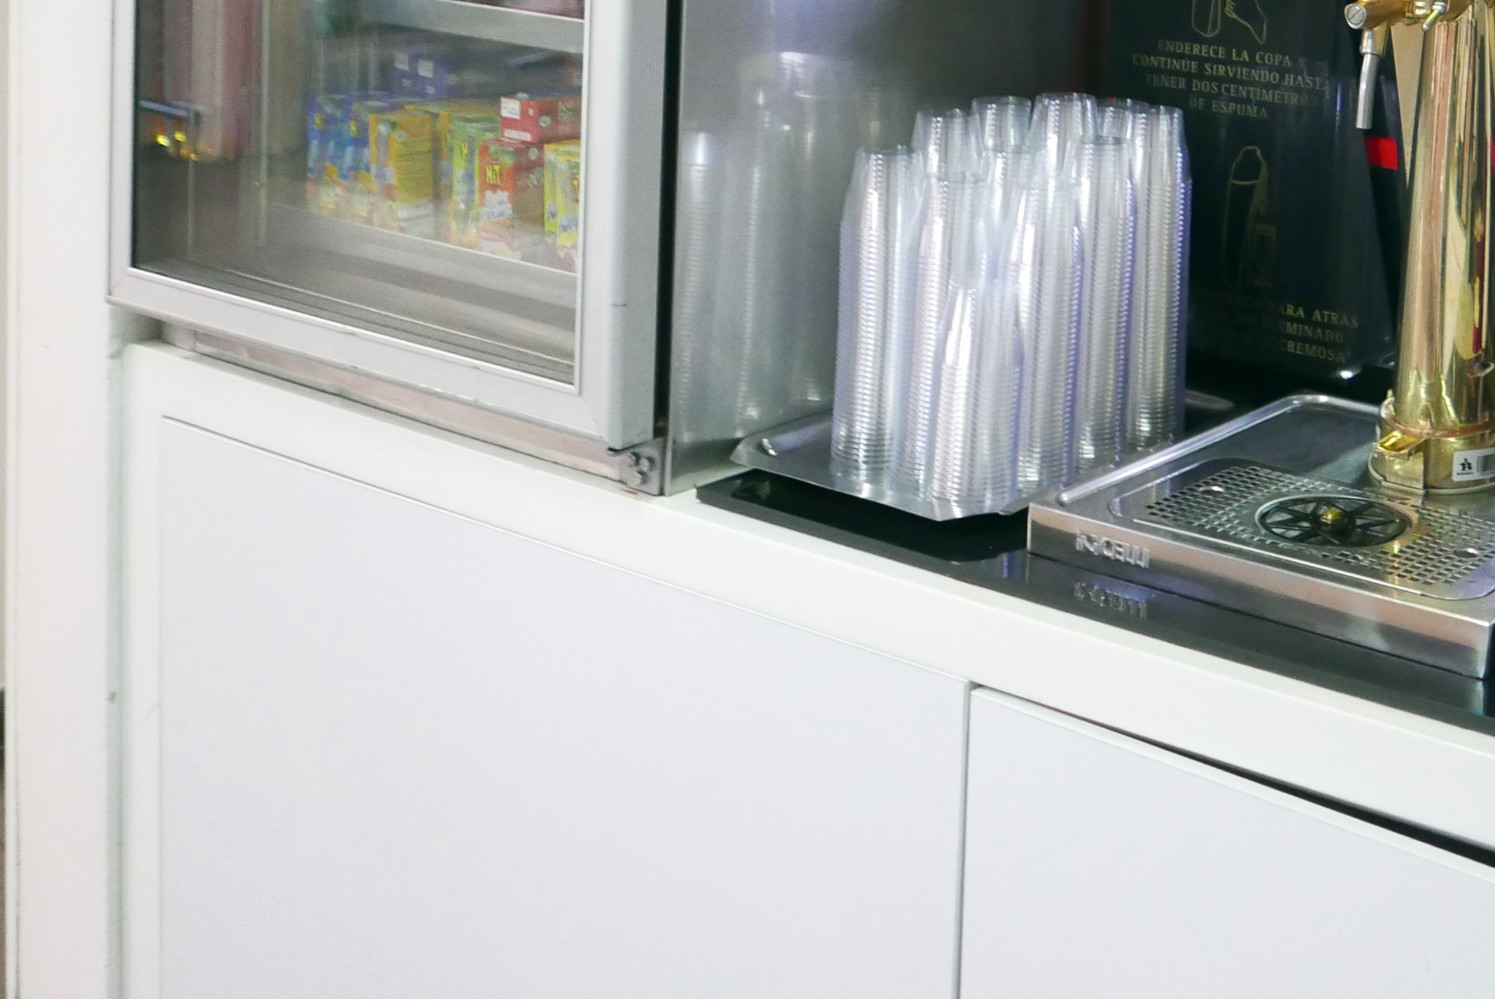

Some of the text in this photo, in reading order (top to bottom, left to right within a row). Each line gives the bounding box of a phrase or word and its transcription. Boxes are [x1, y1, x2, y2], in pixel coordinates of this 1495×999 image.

[1157, 39, 1227, 59] ENDERECE
[1231, 47, 1250, 62] LA
[1255, 51, 1291, 68] COPA
[1203, 62, 1279, 84] SIRVIENDO
[1145, 74, 1186, 91] TENER
[1191, 79, 1218, 96] DOS
[1211, 101, 1268, 121] ESPUMA
